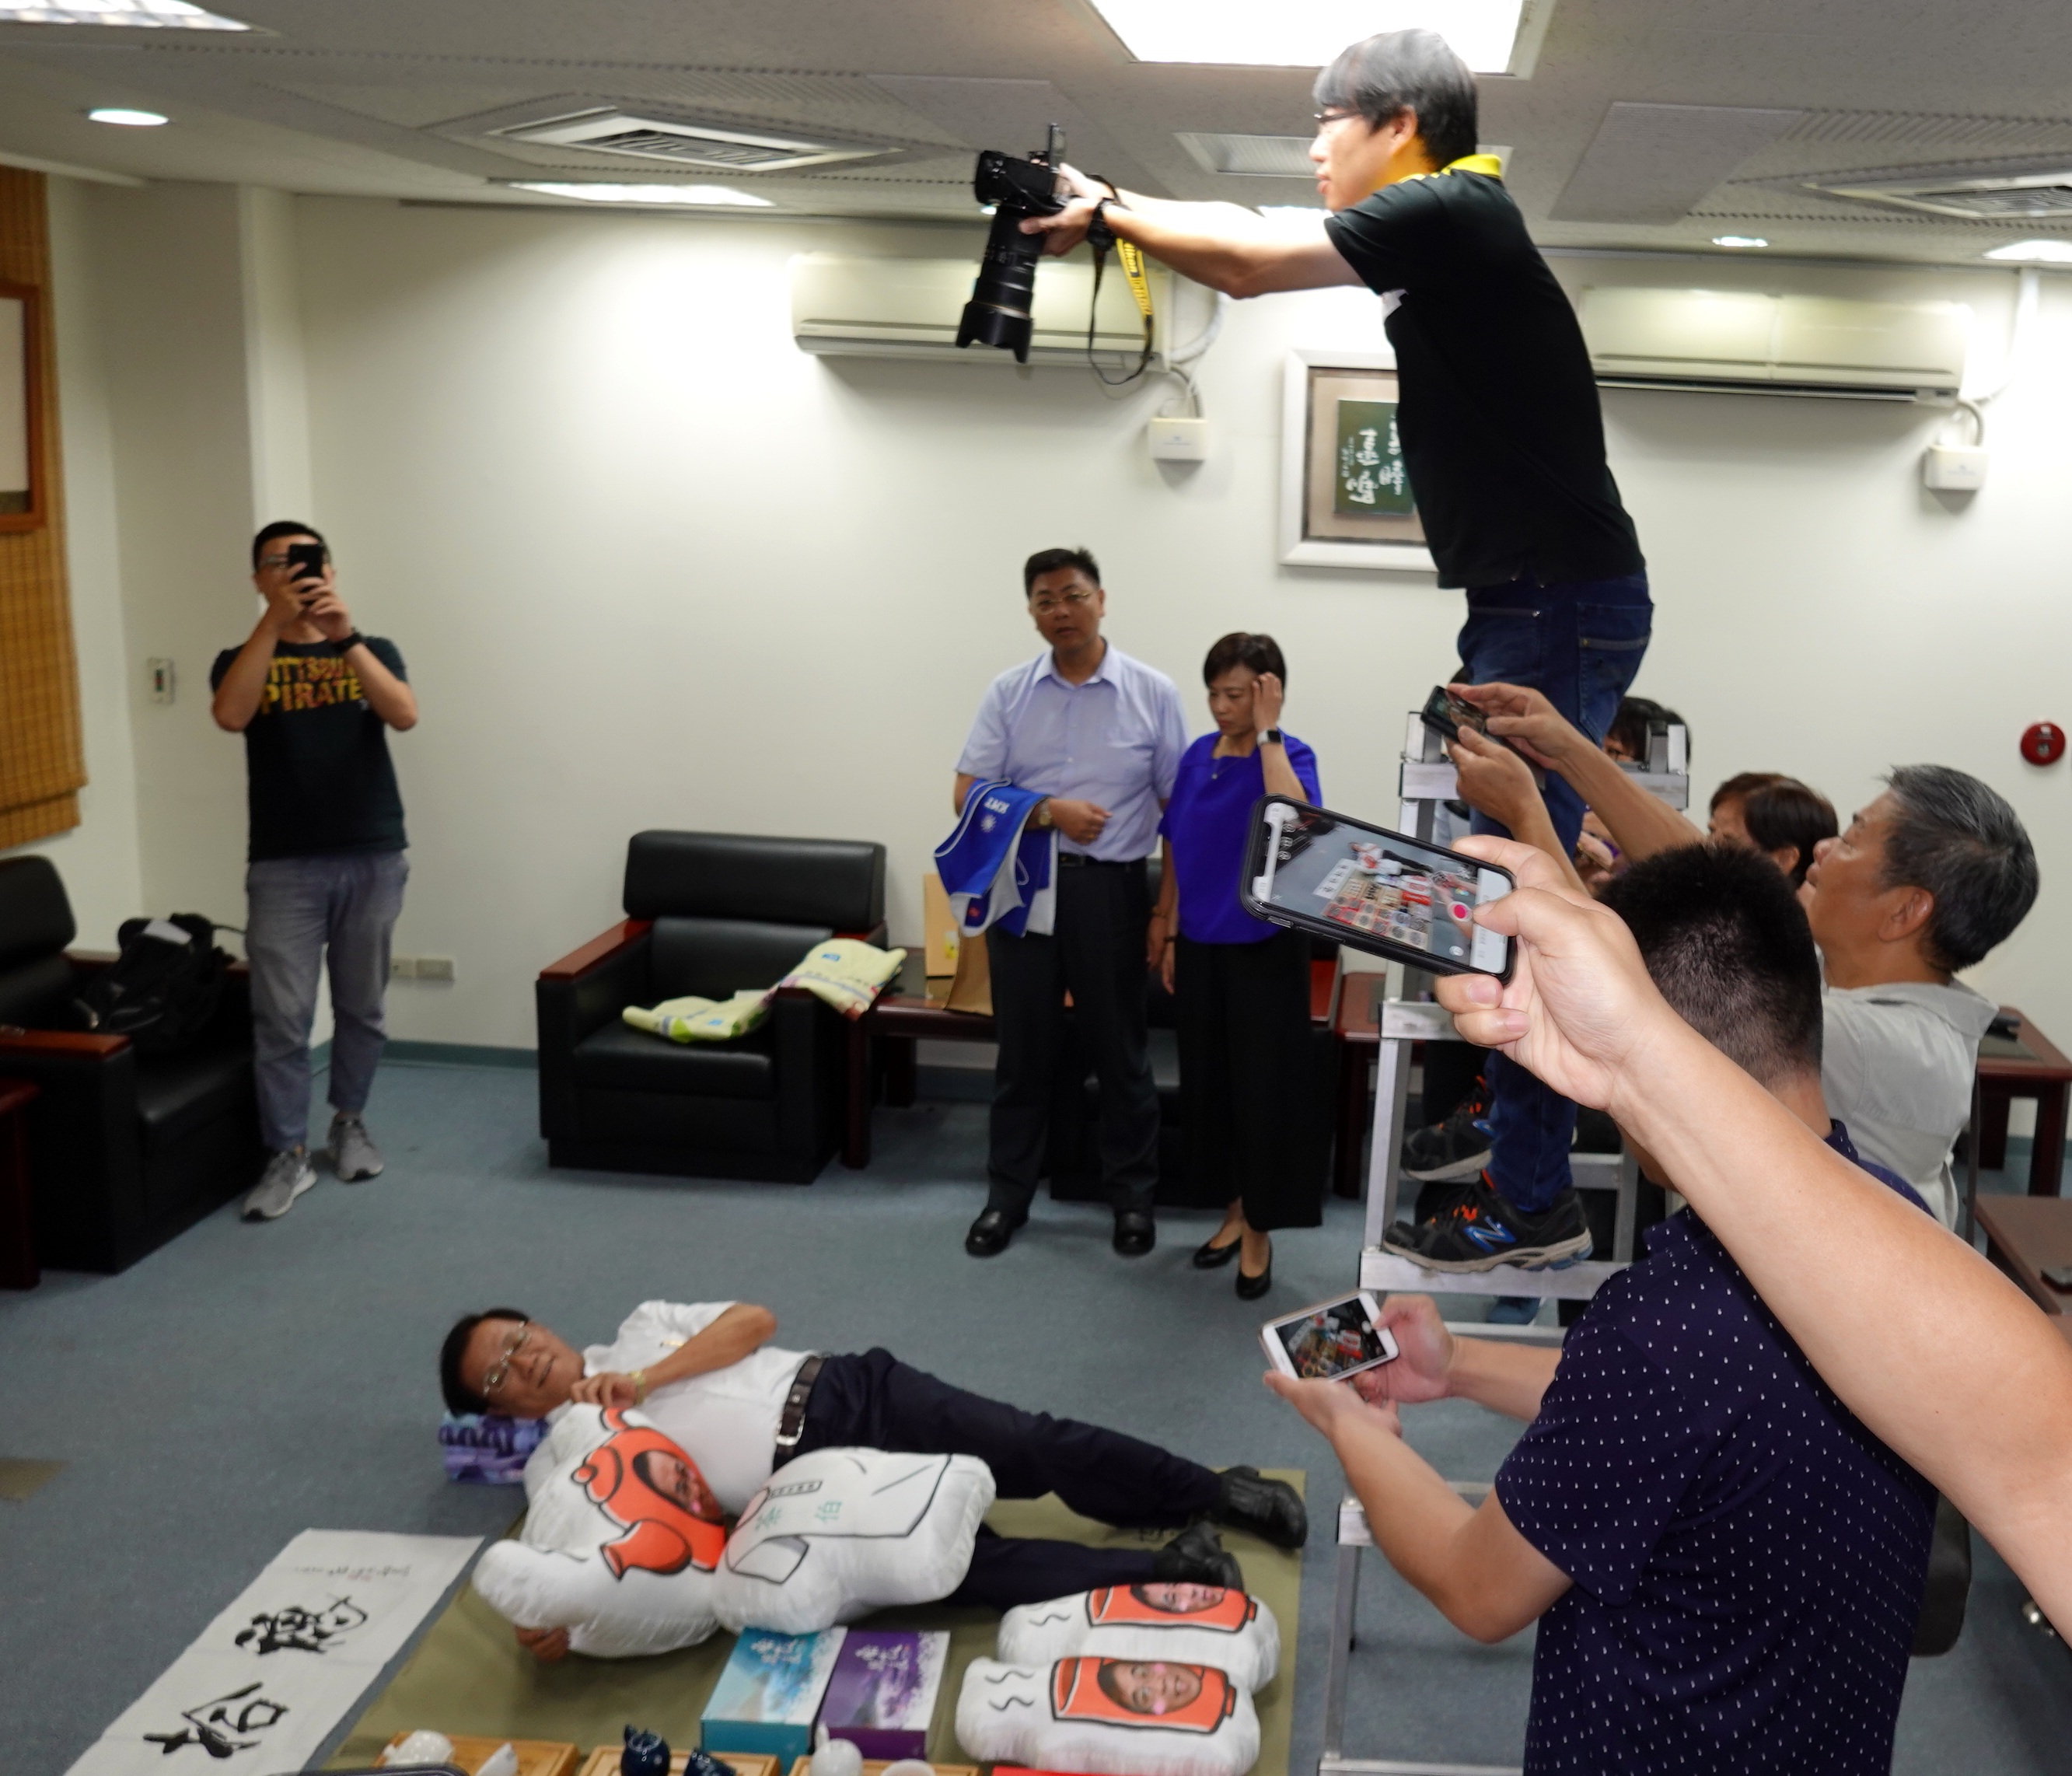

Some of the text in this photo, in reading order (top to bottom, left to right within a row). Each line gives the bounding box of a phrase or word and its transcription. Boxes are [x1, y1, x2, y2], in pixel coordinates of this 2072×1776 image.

[261, 678, 362, 715] PIRATE
[984, 796, 1010, 814] KMT
[1464, 1216, 1516, 1251] N
